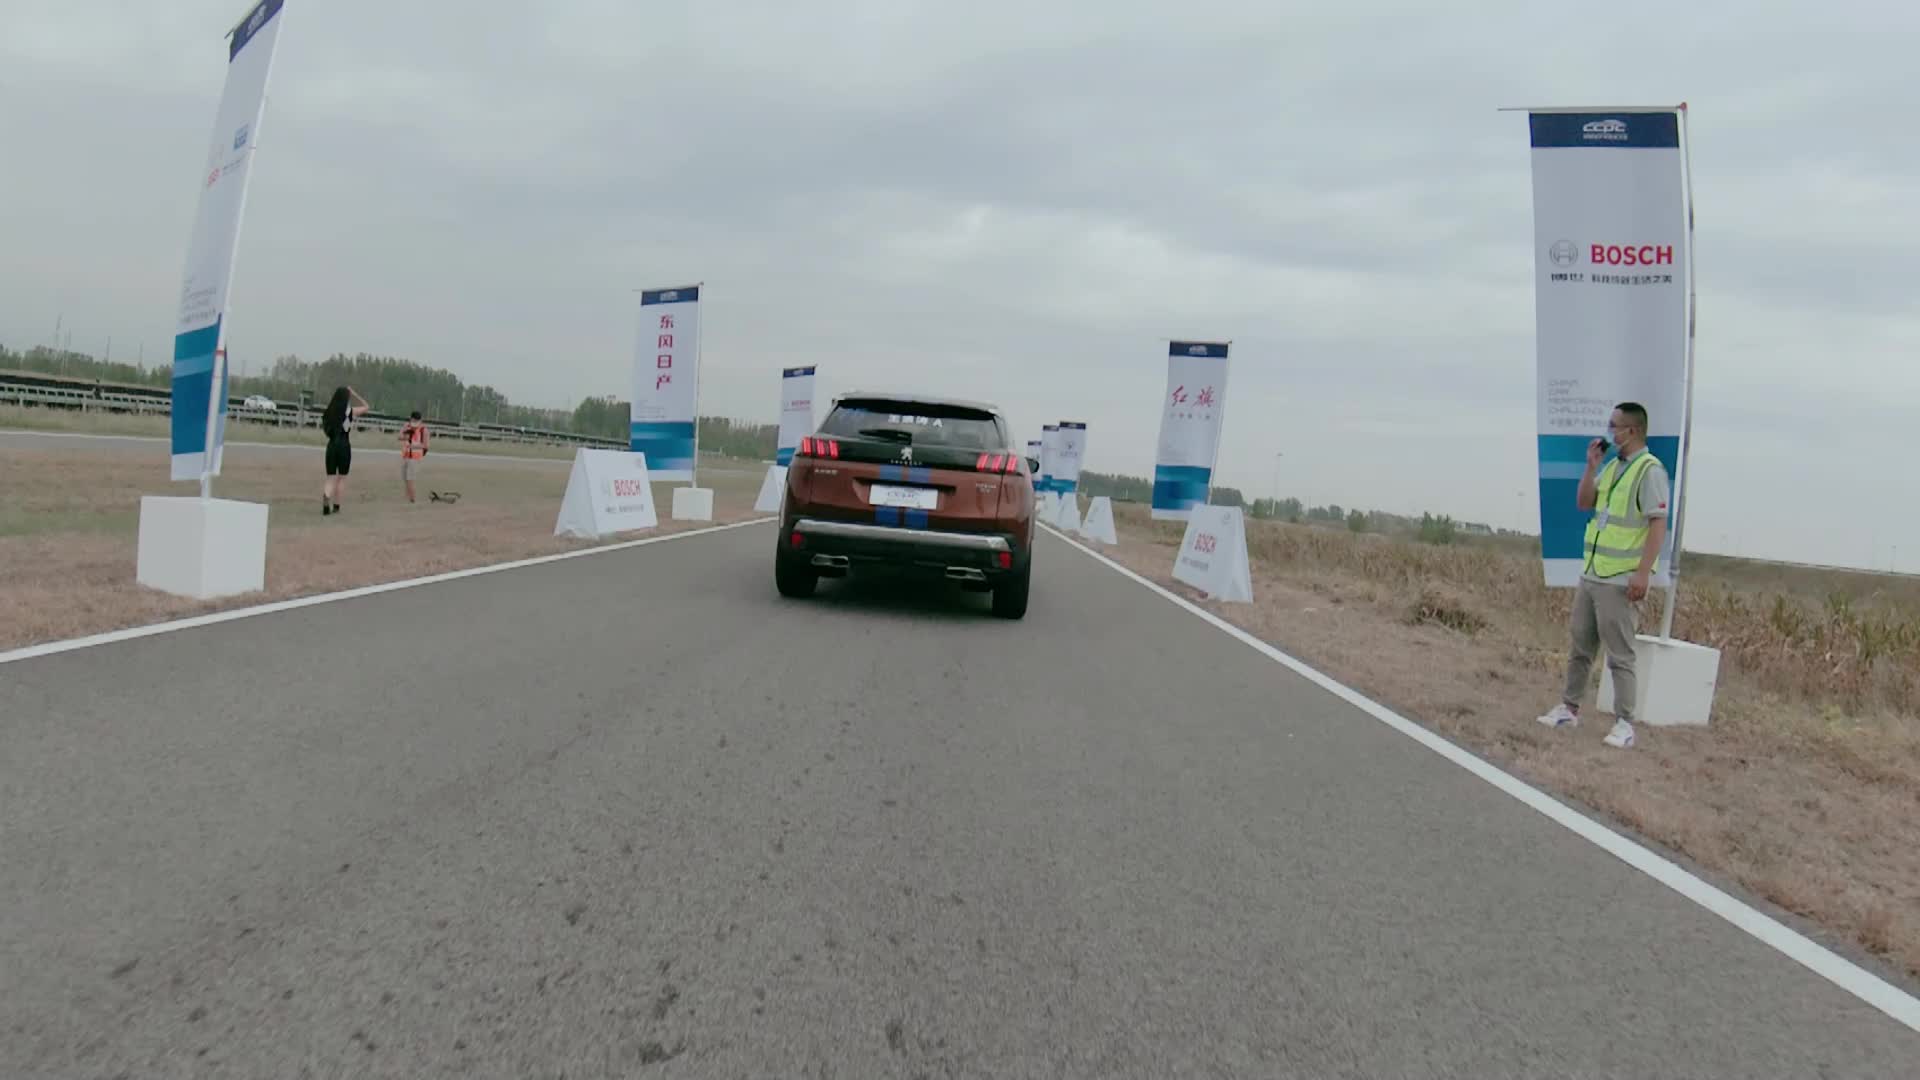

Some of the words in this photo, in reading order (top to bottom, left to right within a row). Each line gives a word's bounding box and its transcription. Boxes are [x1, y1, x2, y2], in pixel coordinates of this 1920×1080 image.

[1591, 244, 1673, 266] BOSCH
[656, 314, 674, 390] 东风日产
[1171, 385, 1216, 408] 红旗
